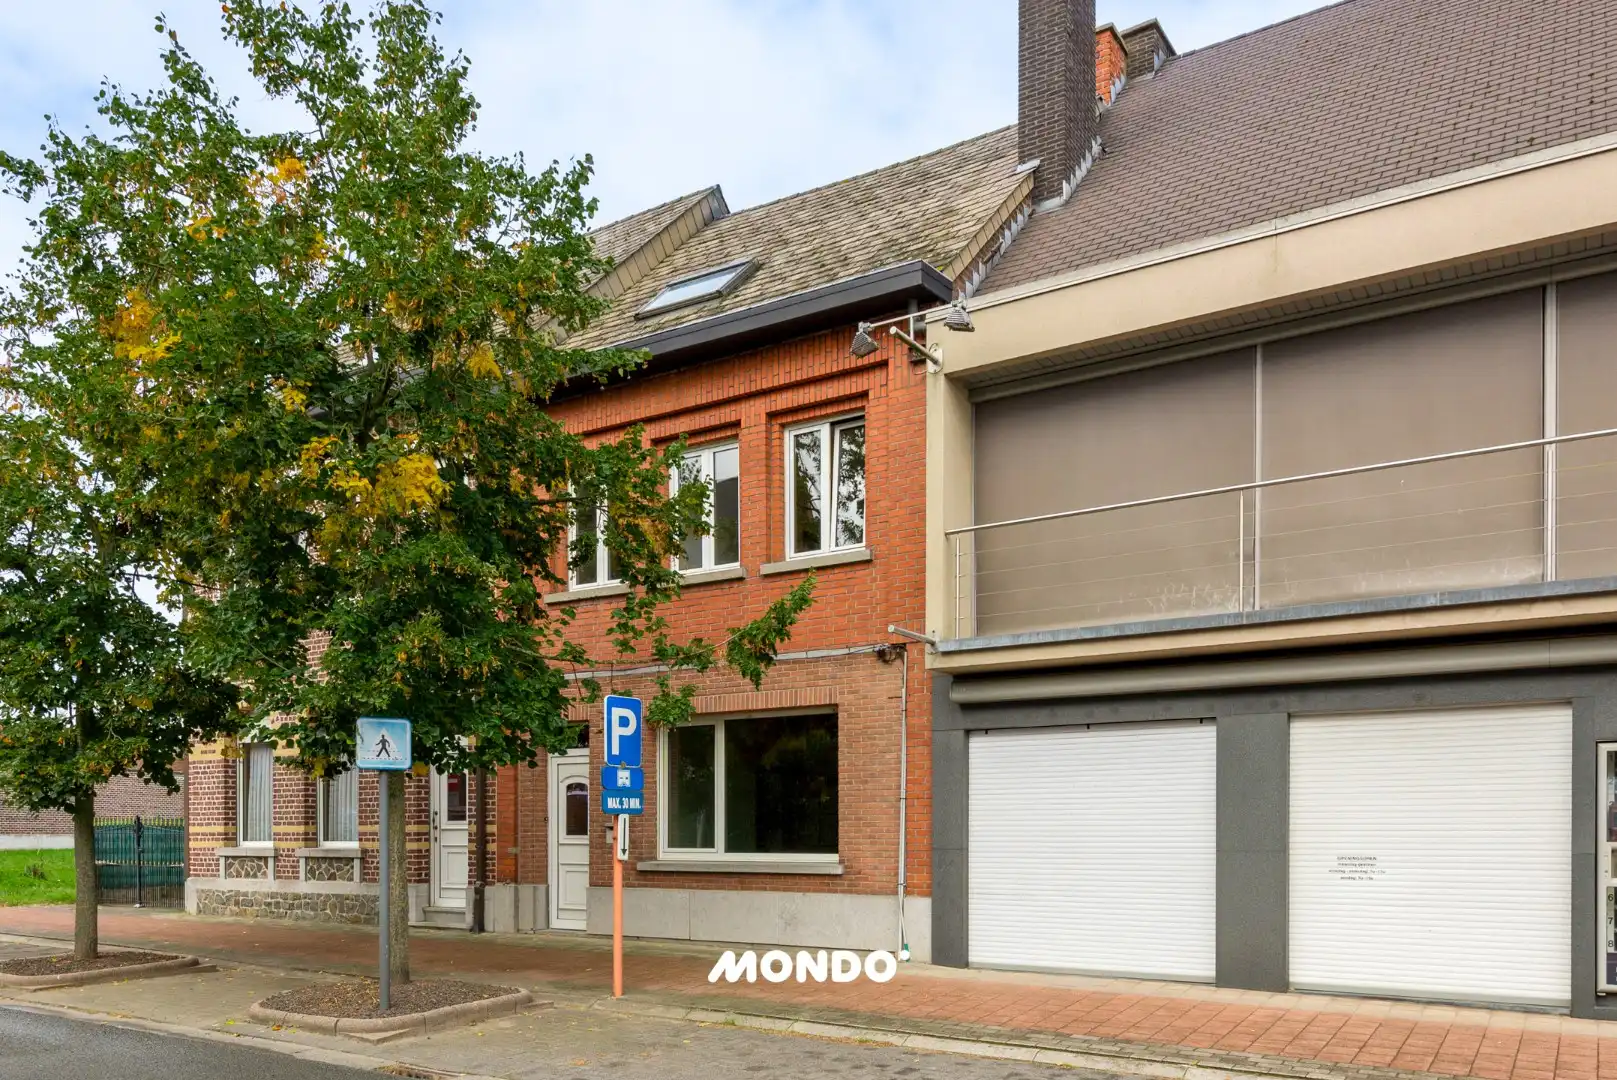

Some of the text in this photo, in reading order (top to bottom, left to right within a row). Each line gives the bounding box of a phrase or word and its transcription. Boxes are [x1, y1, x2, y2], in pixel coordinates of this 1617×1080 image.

[611, 707, 637, 756] P
[607, 797, 642, 809] MAX. 30 MIN.
[1607, 893, 1614, 902] 6
[1608, 917, 1613, 925] 7
[1607, 940, 1614, 948] 8
